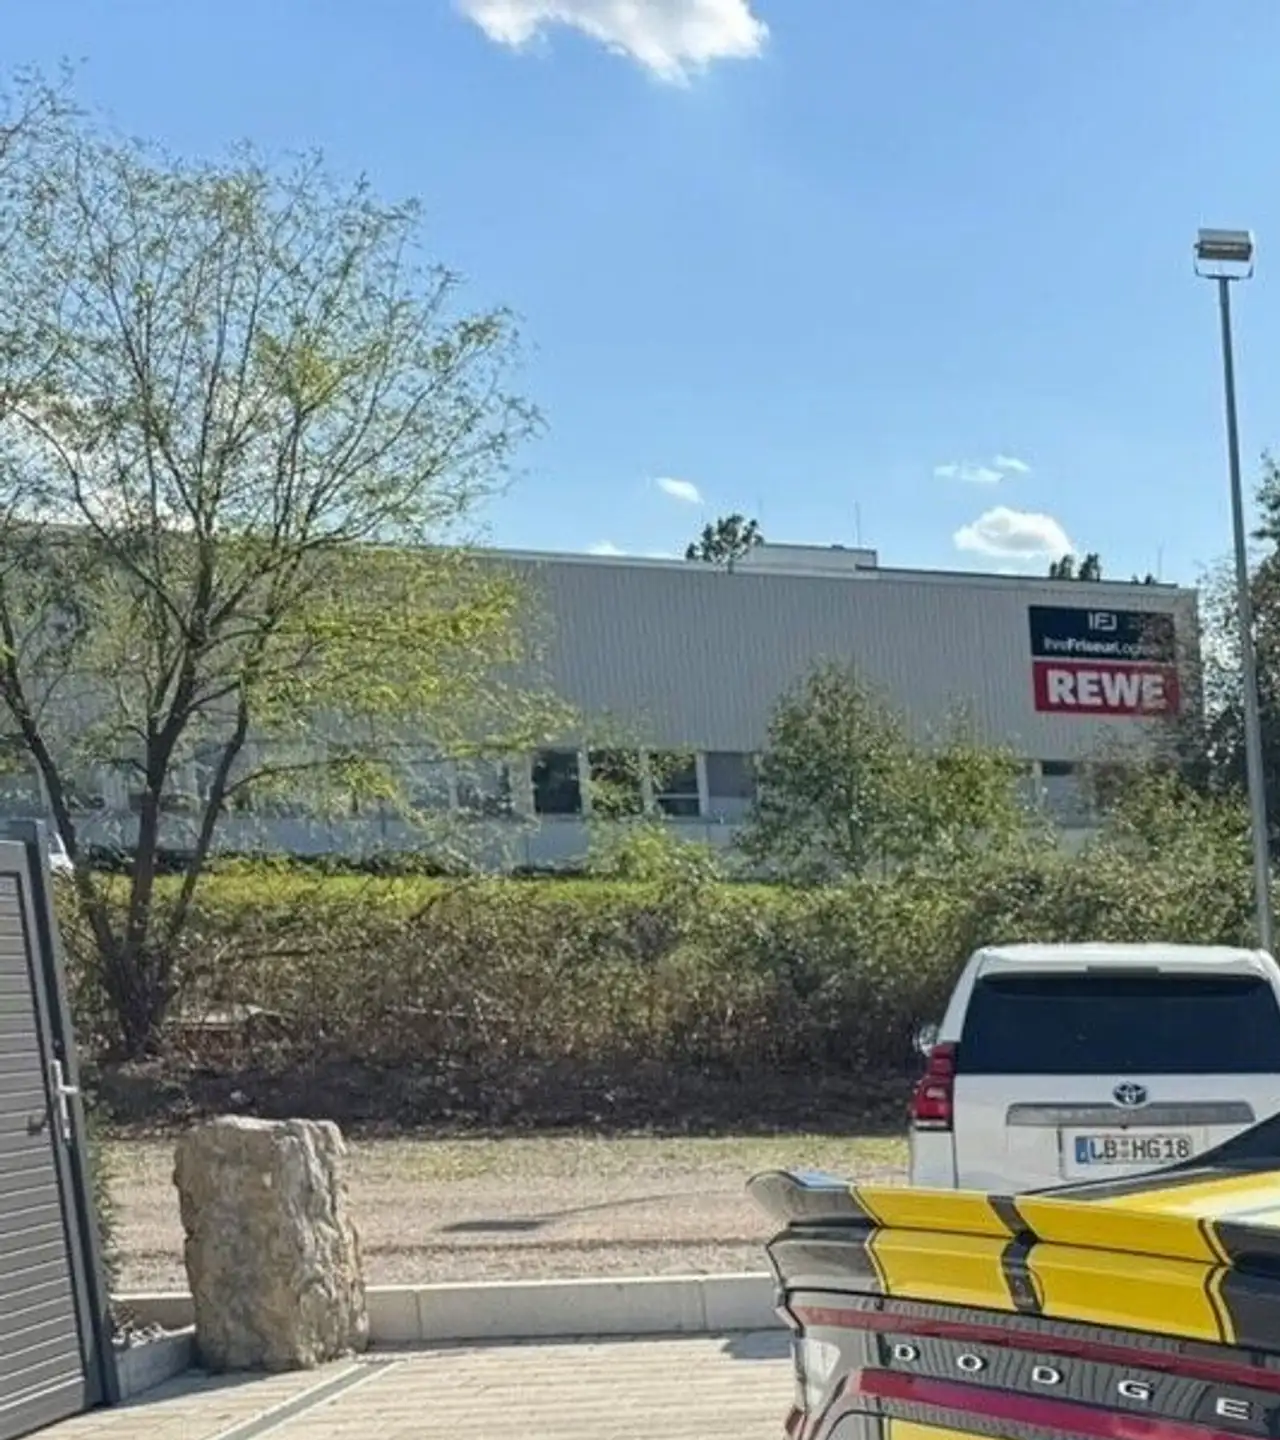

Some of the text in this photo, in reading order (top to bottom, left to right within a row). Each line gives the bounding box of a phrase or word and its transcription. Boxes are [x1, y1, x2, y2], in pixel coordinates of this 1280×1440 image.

[1046, 668, 1167, 710] REWE
[1089, 1138, 1118, 1159] LB
[893, 1342, 1253, 1421] DODGE
